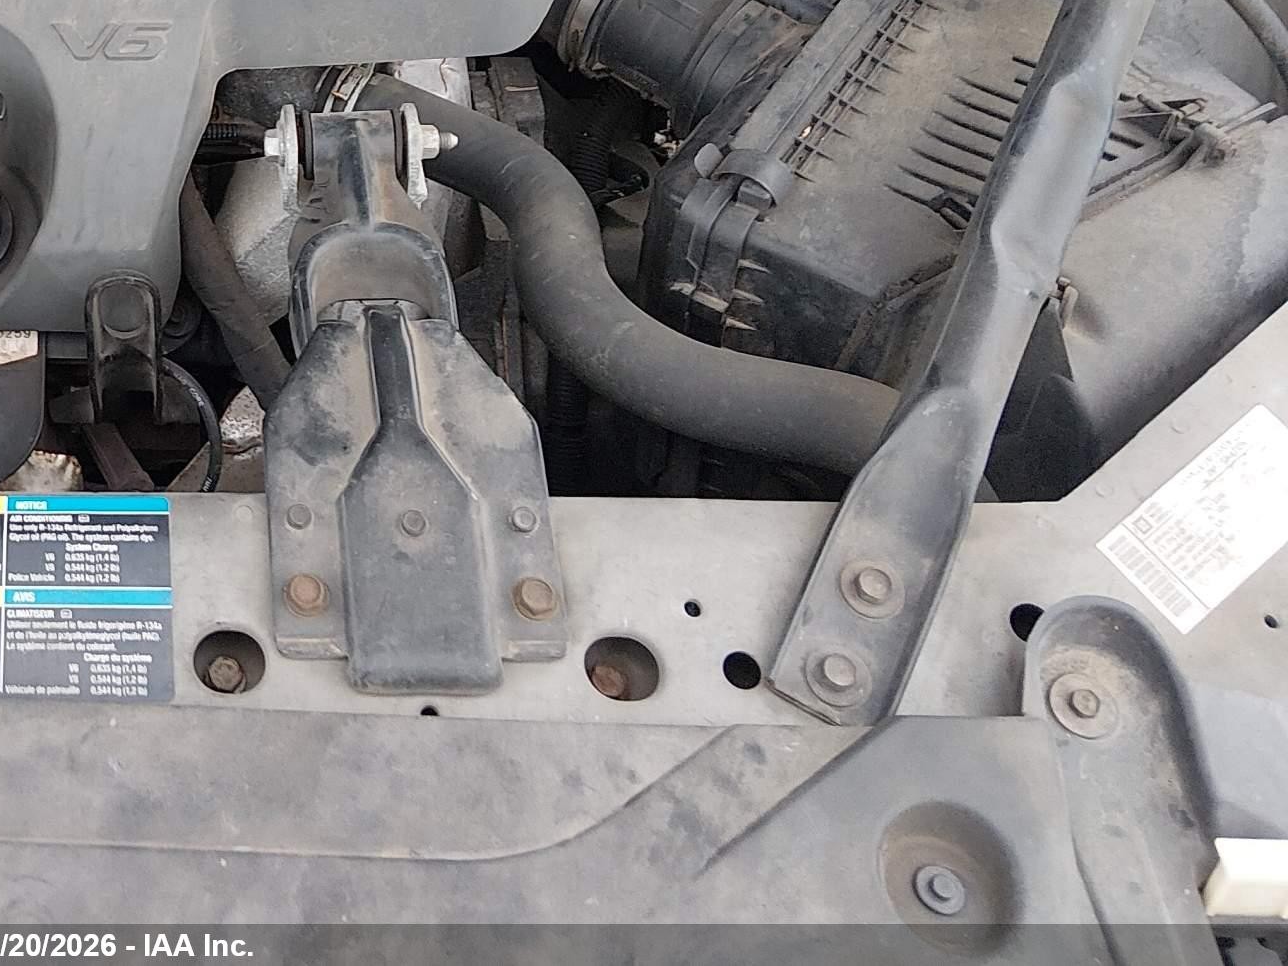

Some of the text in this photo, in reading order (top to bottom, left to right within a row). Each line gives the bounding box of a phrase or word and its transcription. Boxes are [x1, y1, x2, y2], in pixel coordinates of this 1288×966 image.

[50, 19, 173, 62] V6
[65, 543, 118, 552] System Charge
[13, 591, 35, 602] AVIS
